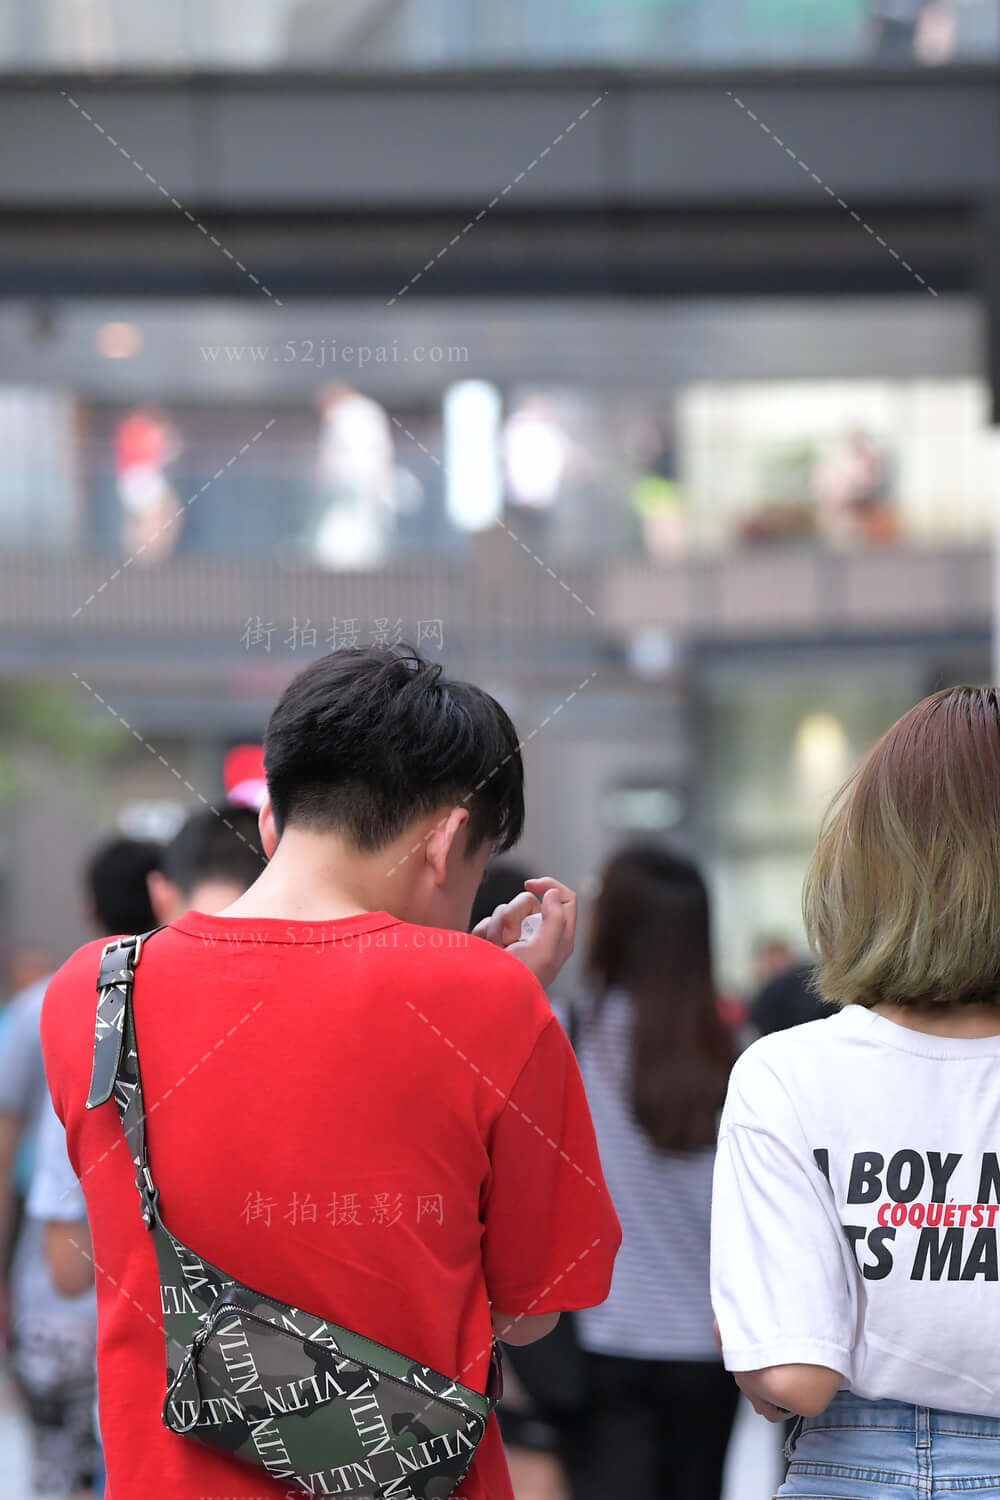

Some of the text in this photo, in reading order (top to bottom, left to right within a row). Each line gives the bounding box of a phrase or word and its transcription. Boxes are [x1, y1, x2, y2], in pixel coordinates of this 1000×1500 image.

[847, 1148, 962, 1204] BOY
[216, 1318, 263, 1394] VLTN
[263, 1371, 348, 1416] VLTN
[346, 1378, 394, 1458] VLTN
[247, 1417, 295, 1480] VLTN
[395, 1429, 475, 1475] VLTN
[294, 1459, 377, 1495] VLTN
